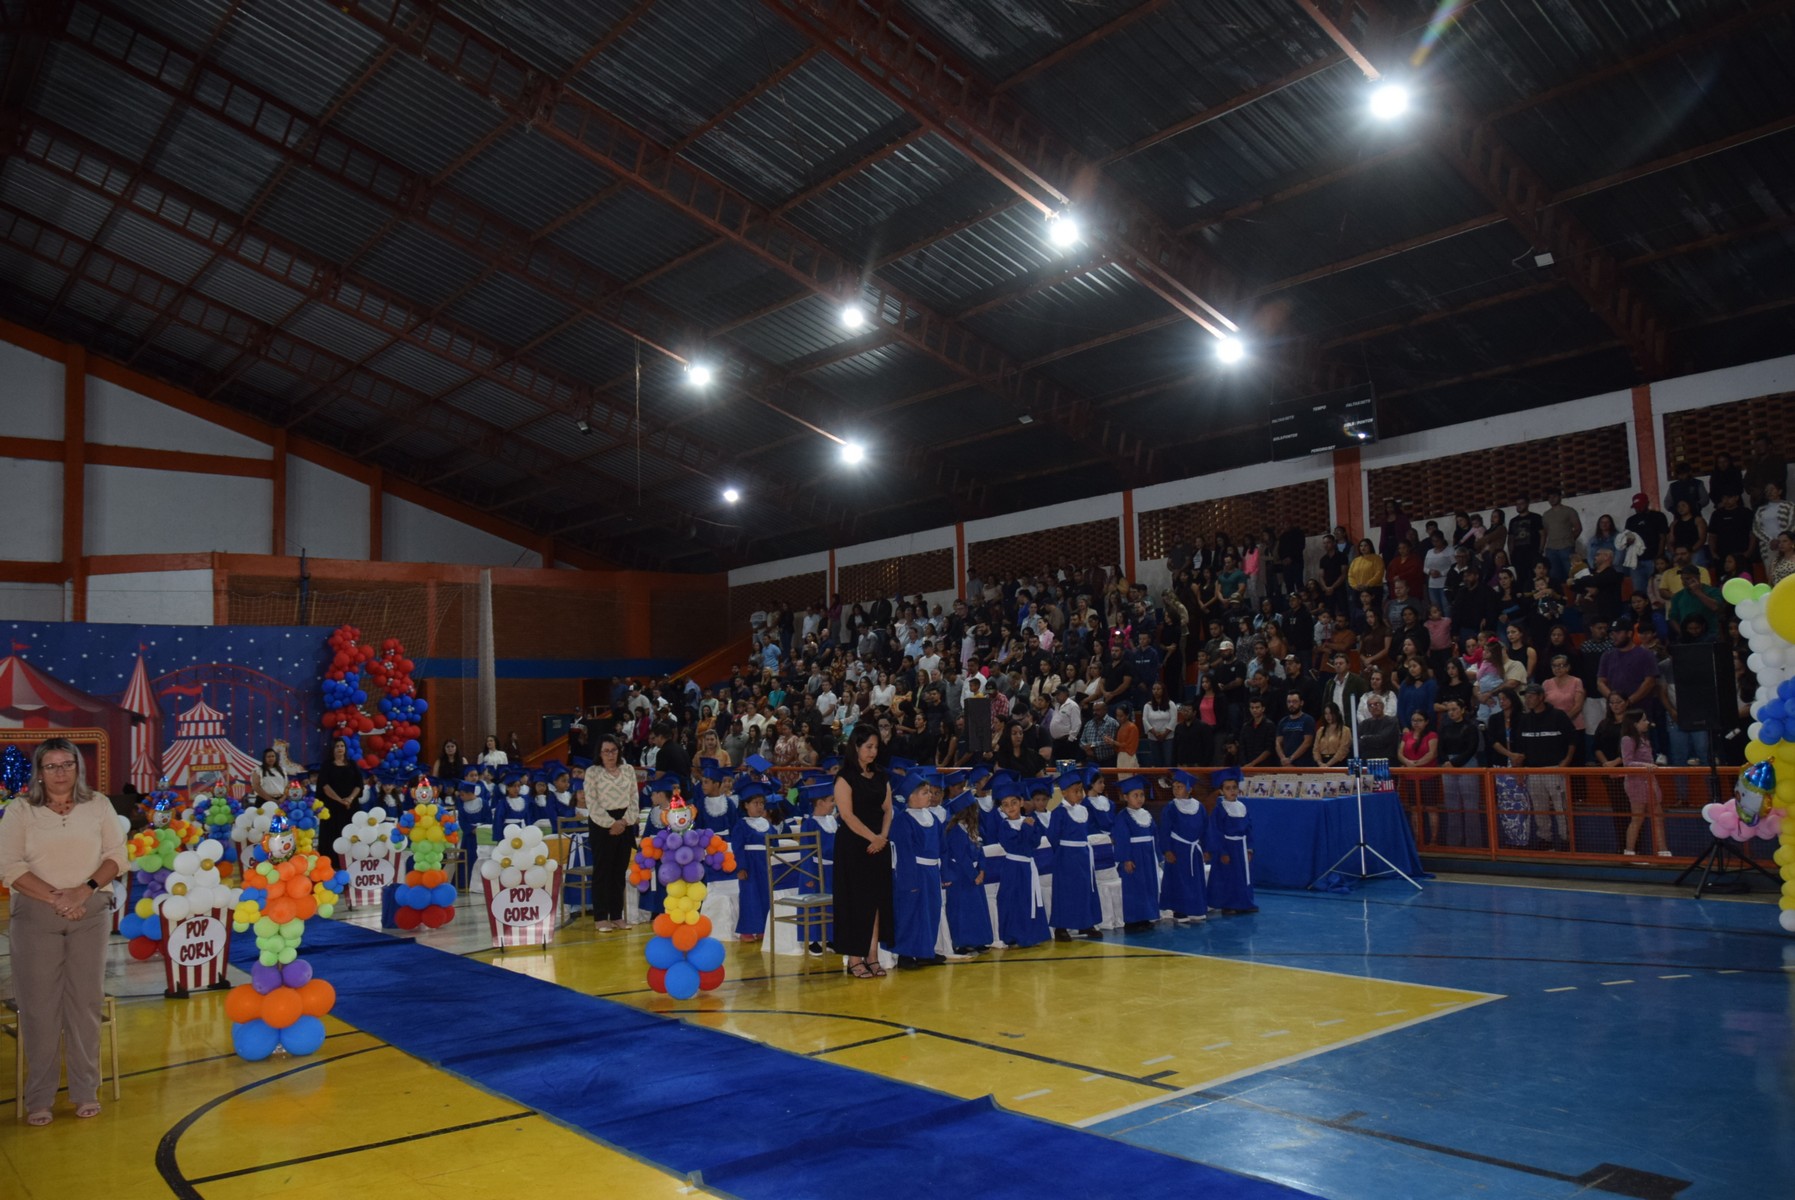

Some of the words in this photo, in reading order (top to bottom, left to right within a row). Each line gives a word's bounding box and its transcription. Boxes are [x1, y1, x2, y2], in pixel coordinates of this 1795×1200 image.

[361, 859, 380, 872] POP
[355, 874, 385, 887] CORN
[510, 887, 534, 903] POP
[504, 906, 540, 922] CORN
[186, 919, 209, 939] POP
[180, 940, 214, 962] CORN
